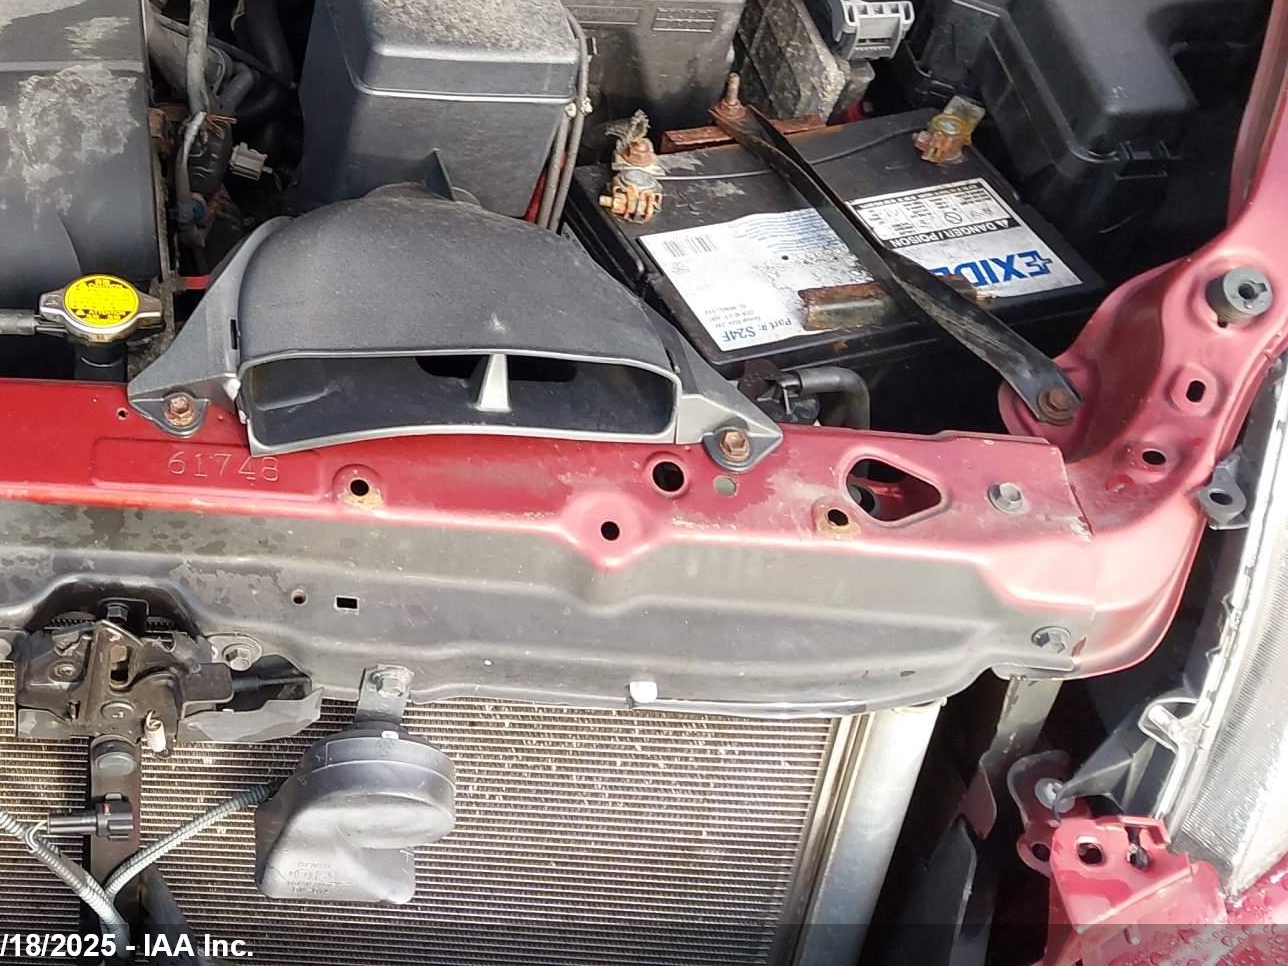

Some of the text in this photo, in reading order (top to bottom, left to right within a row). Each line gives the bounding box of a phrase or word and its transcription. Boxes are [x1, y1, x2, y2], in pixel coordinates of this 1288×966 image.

[943, 221, 999, 238] DANGER
[890, 232, 938, 248] POISON
[928, 250, 1053, 287] EXID
[769, 317, 792, 330] Part
[721, 326, 757, 342] S24F
